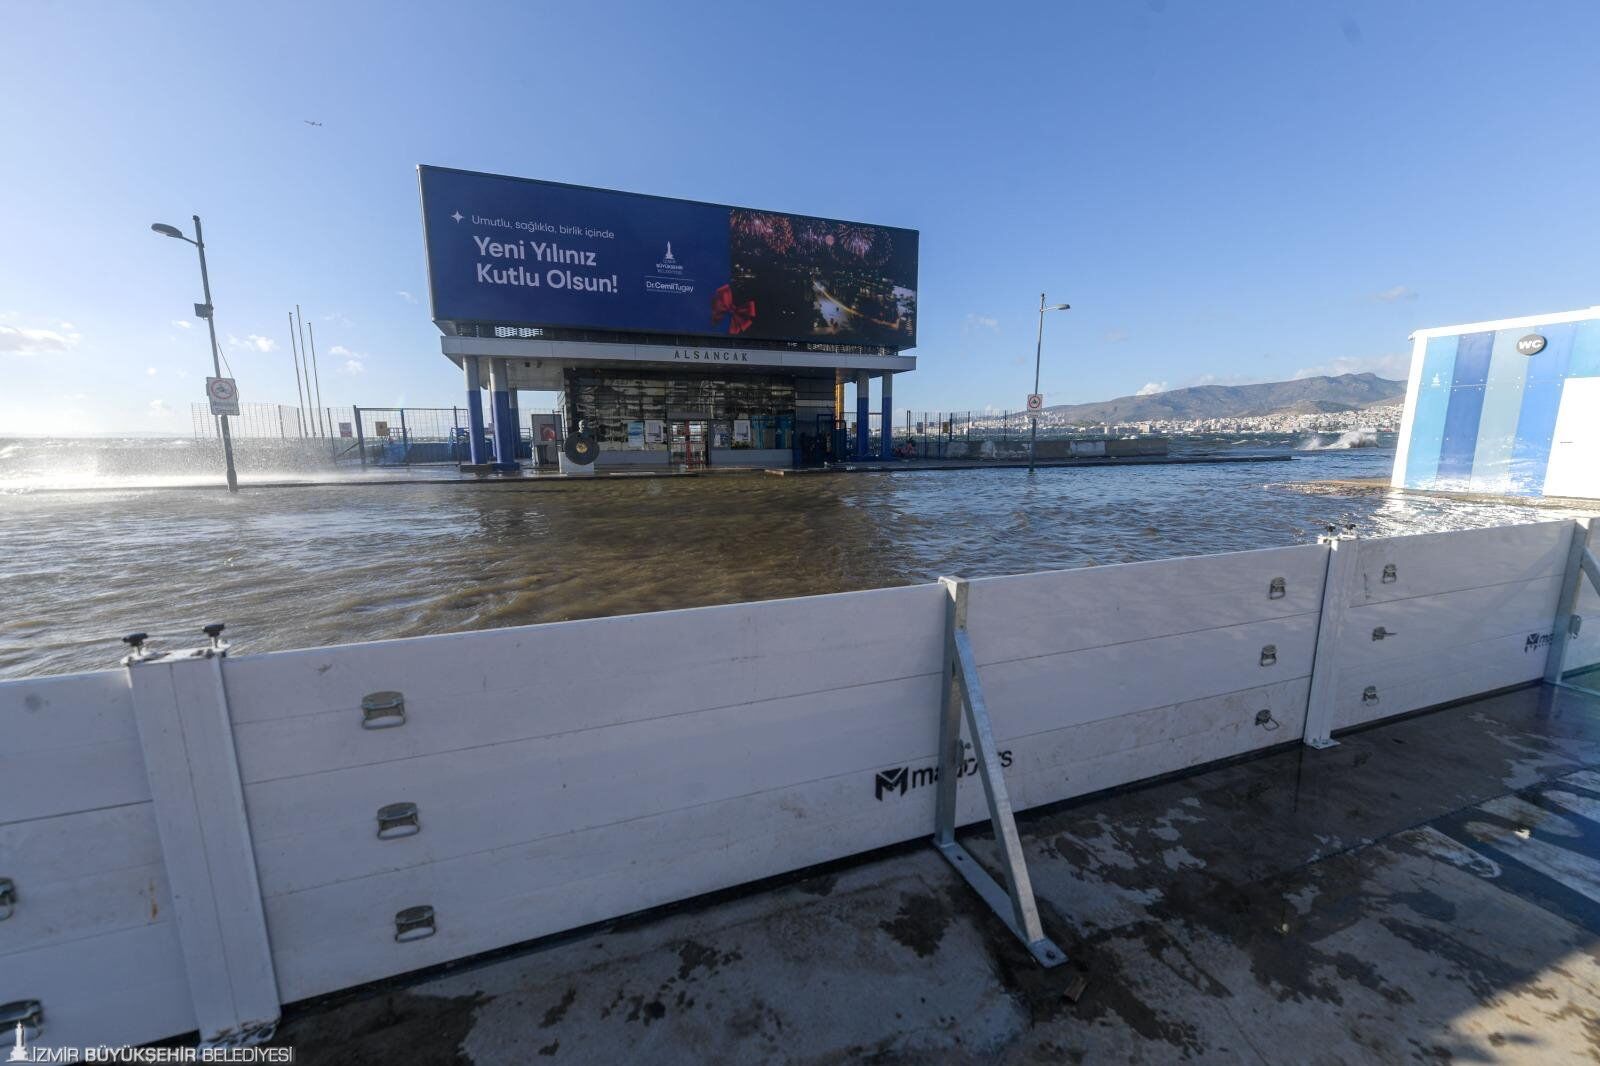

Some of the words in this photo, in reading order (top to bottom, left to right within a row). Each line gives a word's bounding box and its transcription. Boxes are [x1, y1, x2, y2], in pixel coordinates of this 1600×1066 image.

[471, 214, 513, 229] Umutlu,
[515, 220, 557, 233] sağlıkla,
[559, 224, 583, 236] birlik
[585, 226, 615, 239] içinde
[472, 235, 525, 260] Yeni
[530, 241, 597, 266] Yılınız
[476, 262, 540, 287] Kutlu
[546, 269, 618, 294] Olsun!
[674, 349, 748, 362] ALSANCAK
[1518, 339, 1543, 350] WC
